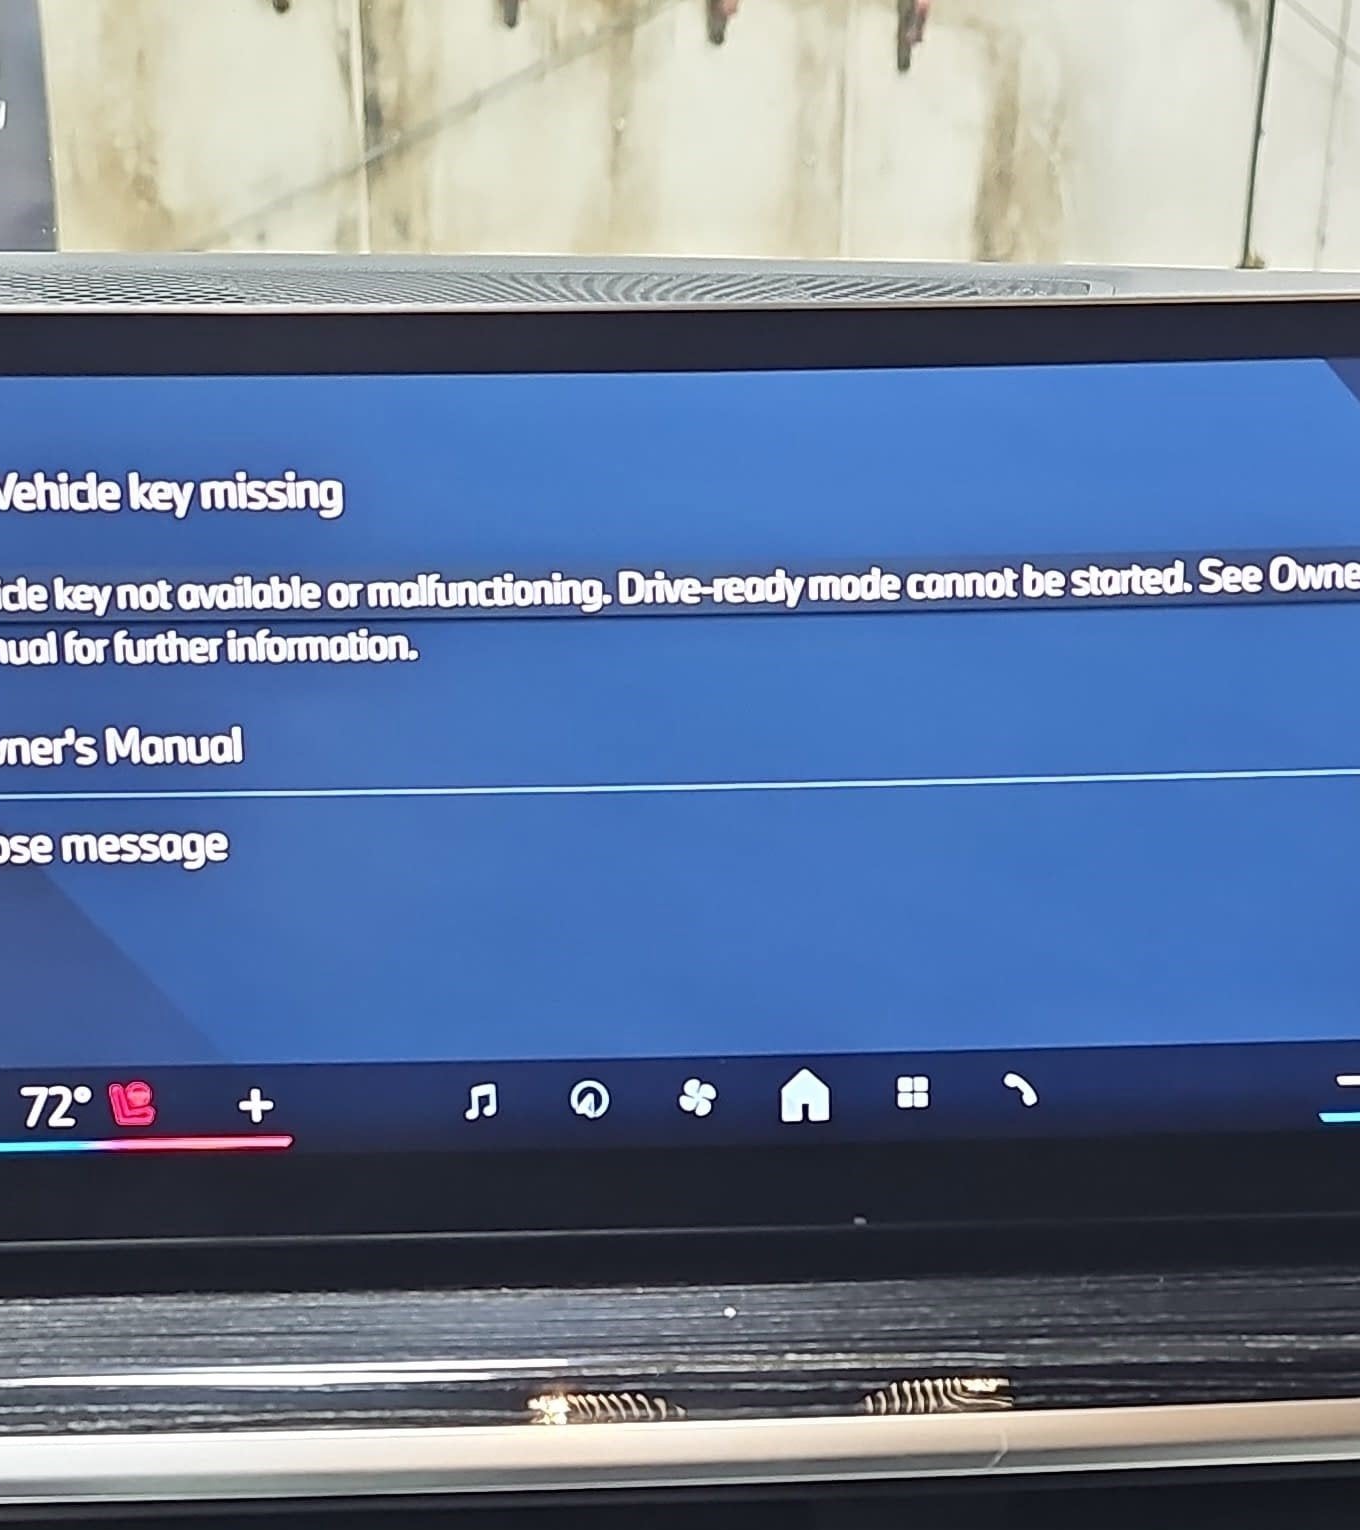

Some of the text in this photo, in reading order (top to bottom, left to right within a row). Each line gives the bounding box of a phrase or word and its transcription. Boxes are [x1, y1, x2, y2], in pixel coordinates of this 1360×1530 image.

[128, 471, 195, 518] key
[200, 471, 344, 519] missing
[53, 577, 113, 617] key
[116, 580, 173, 611] not
[177, 575, 322, 610] available
[327, 582, 364, 609] or
[367, 572, 613, 613] malfunctioning.
[618, 568, 806, 608] Drive-ready
[808, 566, 902, 601] mode
[906, 567, 1019, 600] cannot
[1022, 563, 1066, 598] be
[1070, 559, 1193, 597] started.
[1198, 558, 1263, 594] See
[63, 630, 110, 665] for
[113, 630, 221, 665] further
[226, 628, 419, 663] information.
[105, 726, 243, 765] Manual
[61, 832, 228, 870] message
